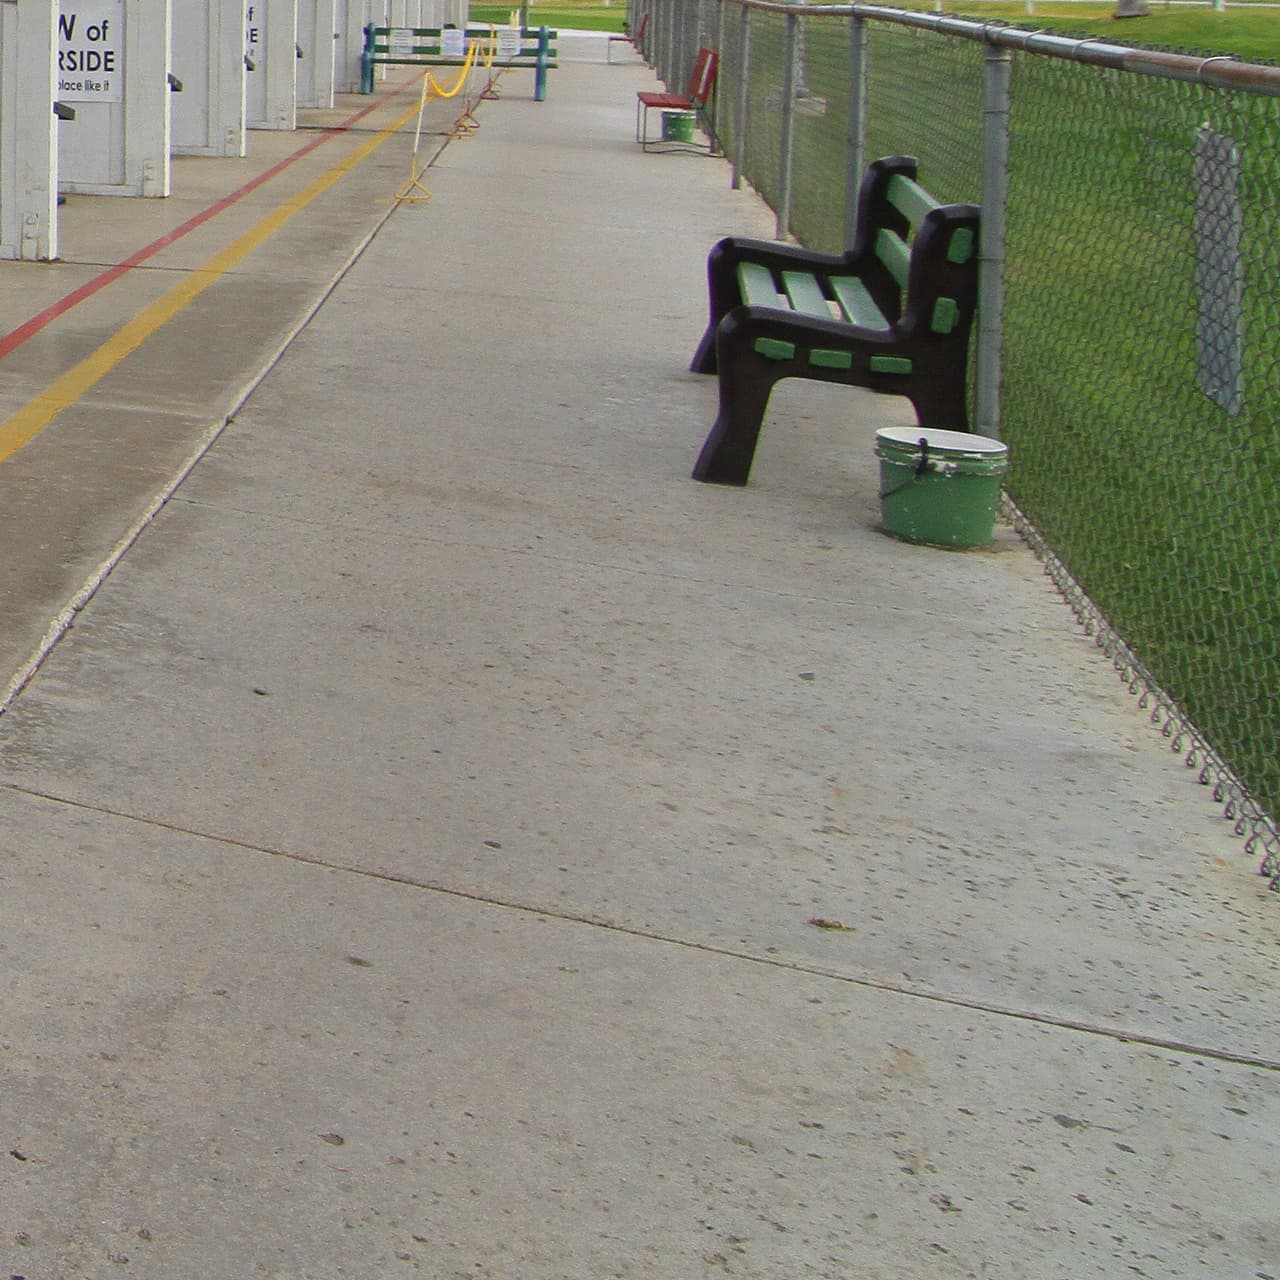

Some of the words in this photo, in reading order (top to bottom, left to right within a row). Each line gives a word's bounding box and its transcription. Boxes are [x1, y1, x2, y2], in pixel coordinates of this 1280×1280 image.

[86, 20, 109, 41] of
[58, 50, 115, 72] RSIDE
[84, 79, 101, 92] like
[103, 79, 110, 92] it
